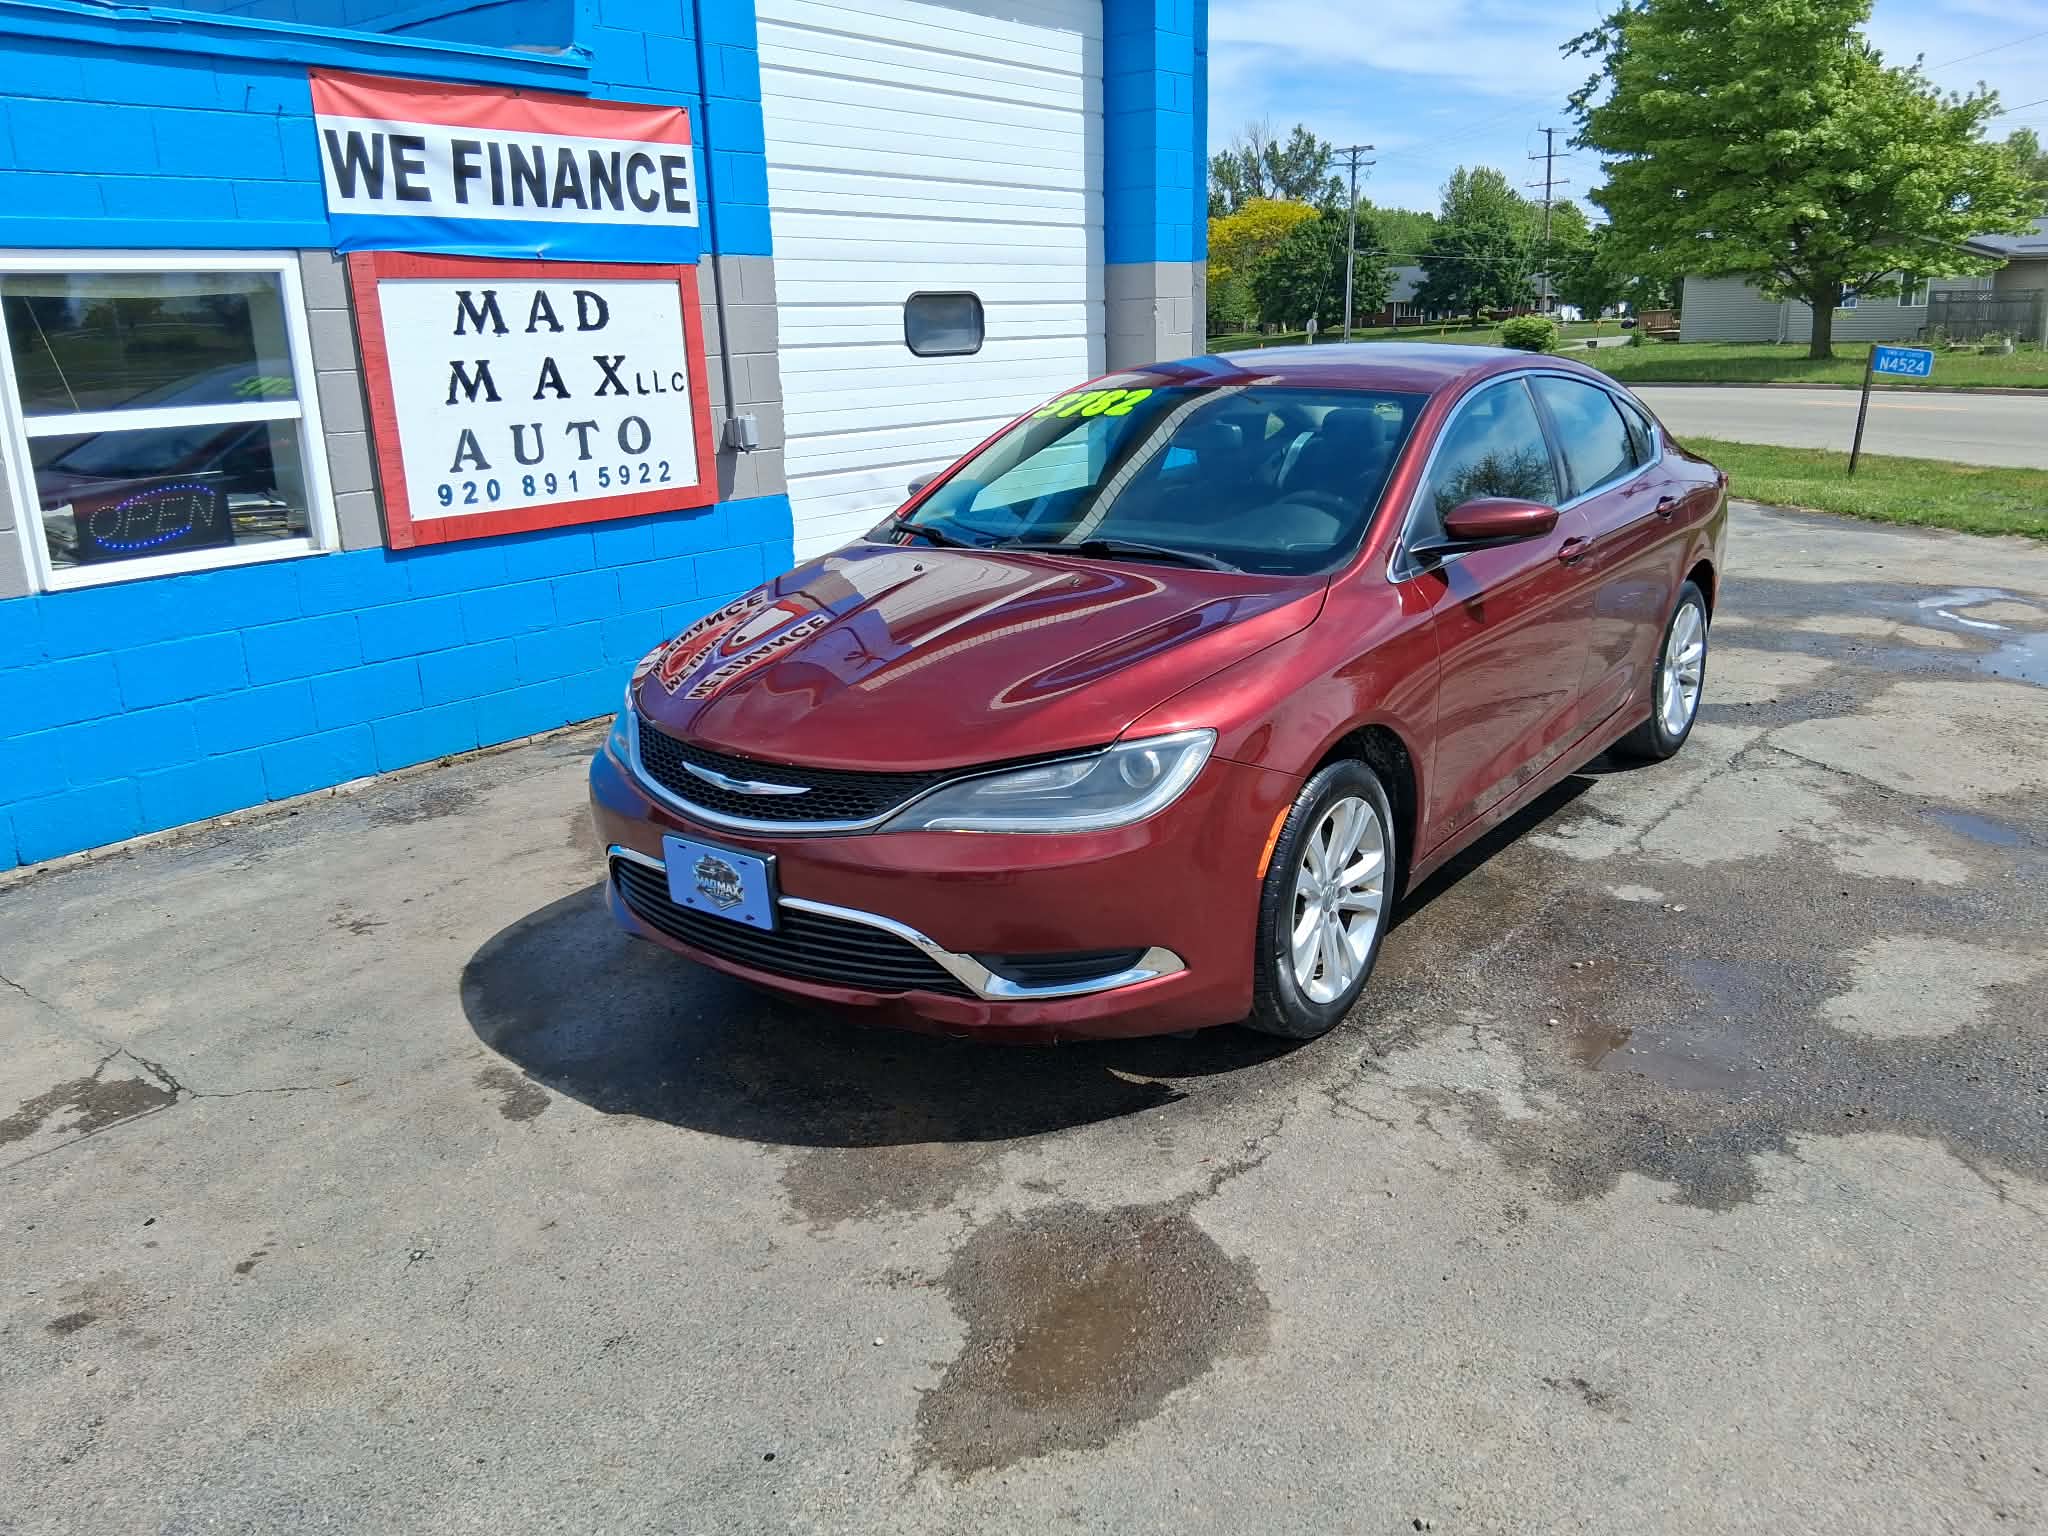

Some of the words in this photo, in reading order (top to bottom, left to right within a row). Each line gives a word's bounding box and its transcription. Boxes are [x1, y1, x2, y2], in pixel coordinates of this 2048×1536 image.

[323, 129, 432, 202] WE
[451, 138, 691, 213] FINANCE
[453, 290, 610, 336] MAD
[445, 355, 630, 405] MAX
[635, 370, 685, 395] LLC
[1879, 355, 1925, 374] N4524
[450, 416, 652, 473] AUTO
[437, 478, 501, 507] 920
[522, 470, 579, 497] 891
[598, 460, 671, 488] 5922
[89, 494, 216, 540] OPEN
